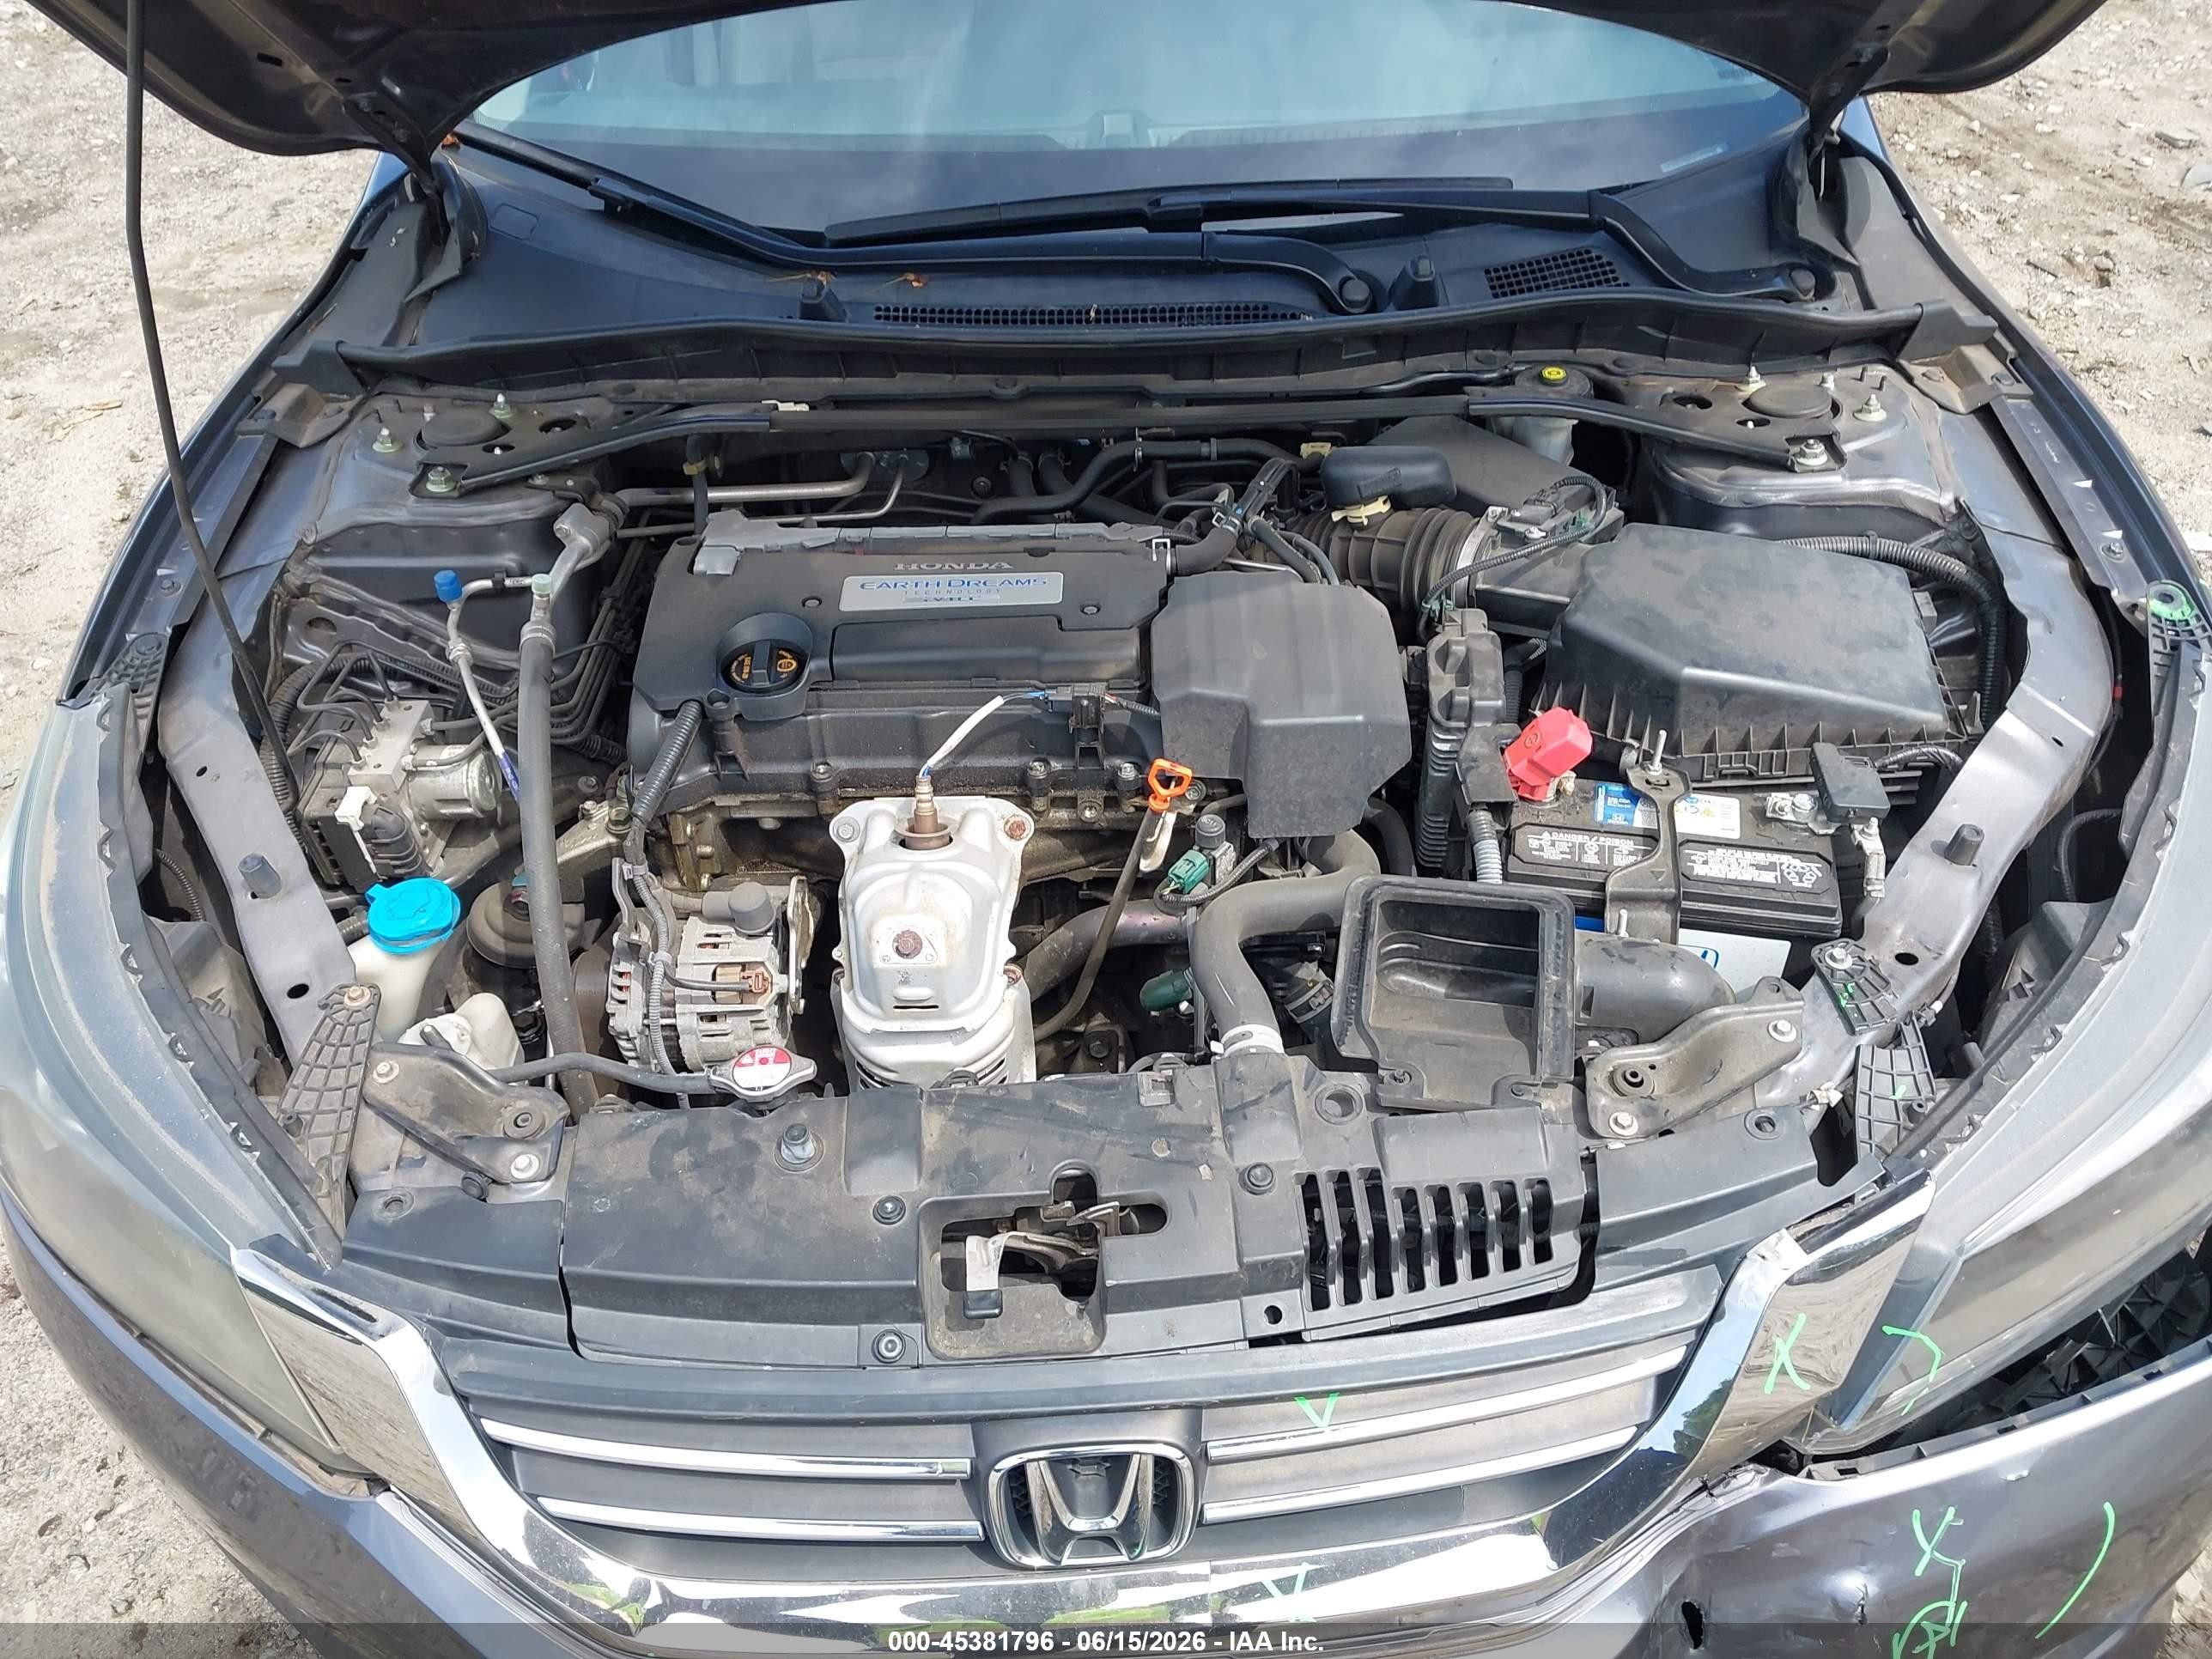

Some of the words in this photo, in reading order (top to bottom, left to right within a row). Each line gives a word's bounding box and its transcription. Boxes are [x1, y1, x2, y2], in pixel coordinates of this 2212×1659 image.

[895, 562, 1014, 570] HONDA
[860, 580, 941, 590] EARTH
[947, 578, 1048, 587] DREAMS
[1552, 831, 1589, 842] DANGER
[1599, 836, 1634, 846] POISON
